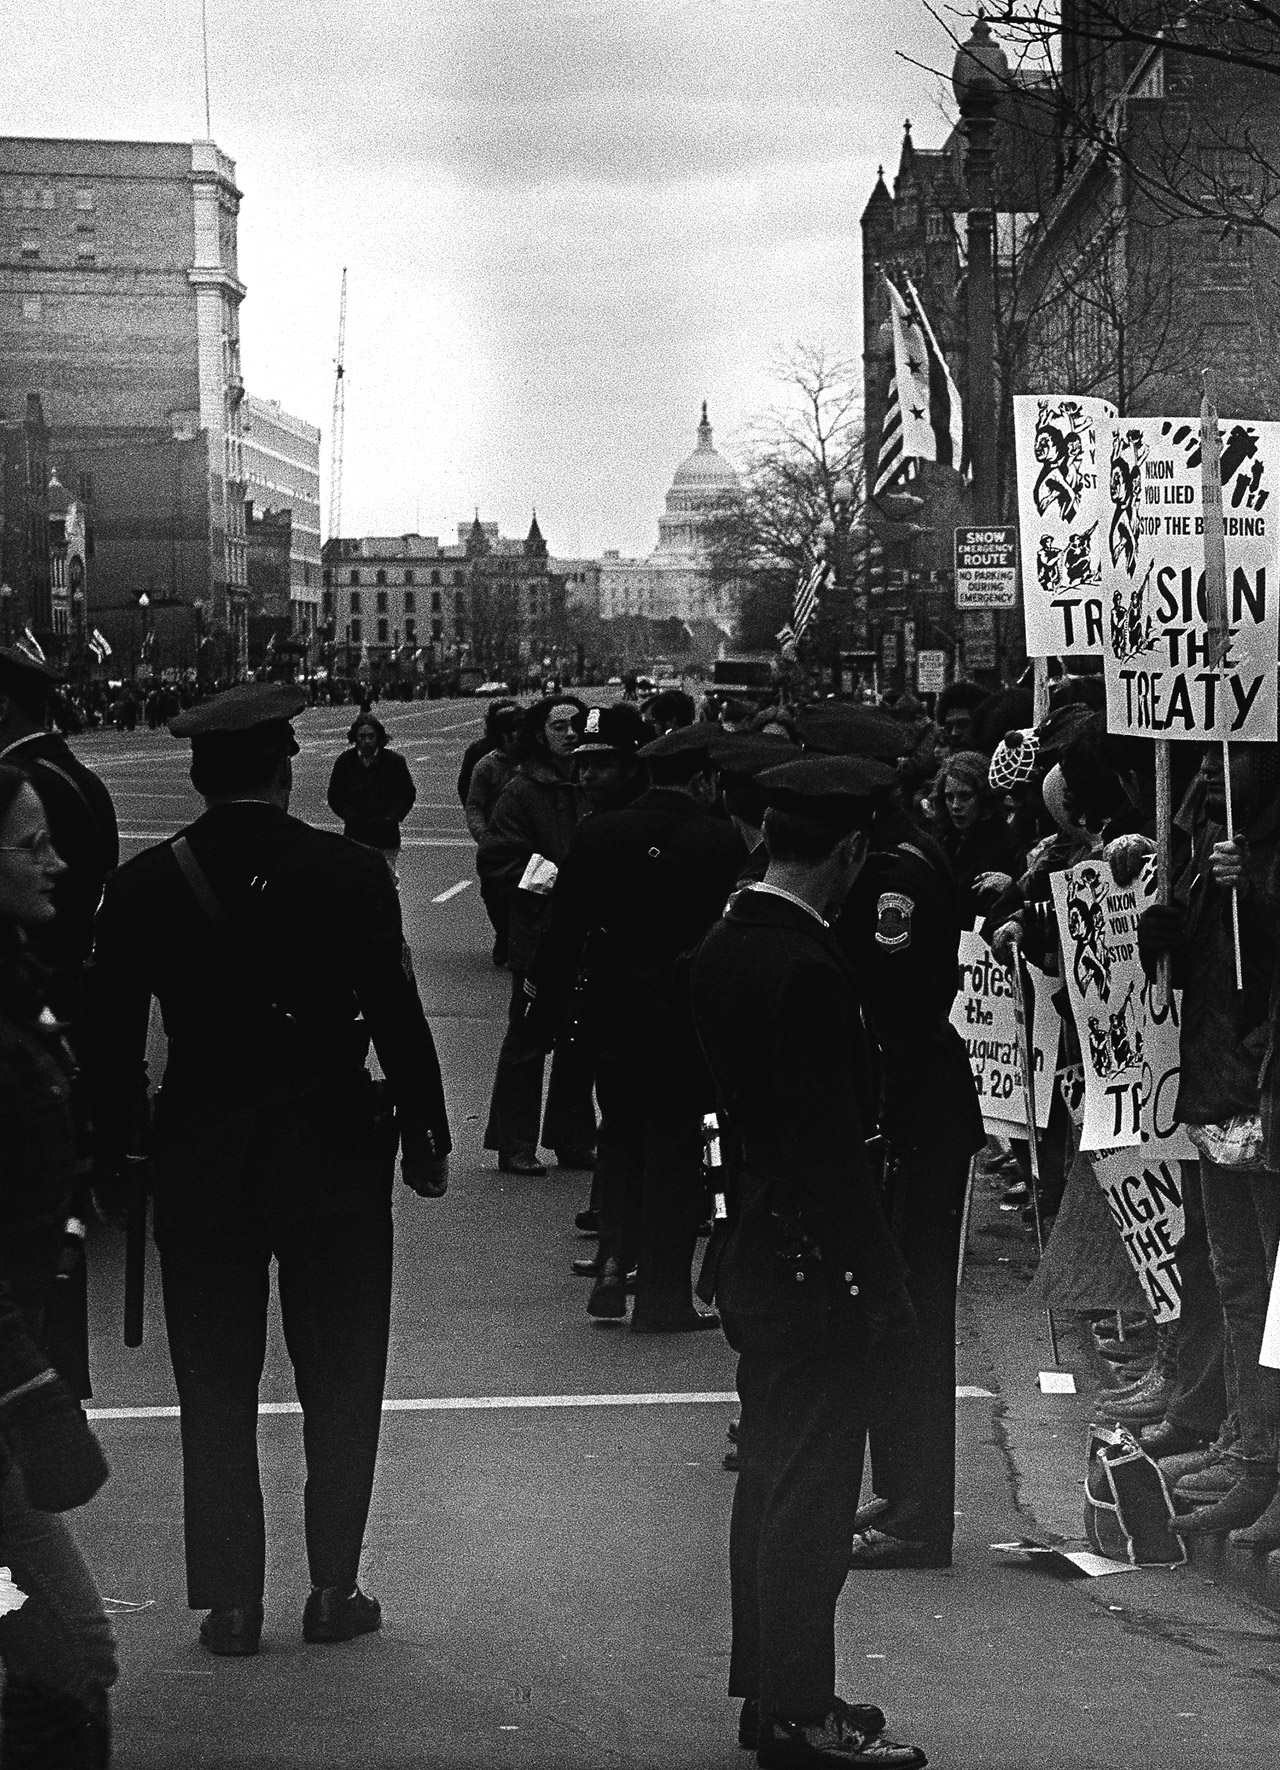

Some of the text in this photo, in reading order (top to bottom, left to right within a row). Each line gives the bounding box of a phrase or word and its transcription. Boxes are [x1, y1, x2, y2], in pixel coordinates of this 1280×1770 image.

[1145, 460, 1174, 480] NIXON
[1144, 485, 1195, 505] YOU LIED
[1140, 516, 1161, 536] STOP
[1164, 516, 1193, 536] THE
[966, 531, 1006, 544] SNOW
[958, 544, 1014, 554] EMERGENCY
[963, 553, 1008, 566] ROUTE
[959, 570, 1014, 581] NO PARKING
[967, 581, 1004, 592] DURING
[959, 592, 1013, 604] EMERGENCY
[1118, 670, 1266, 732] TREATY
[1107, 892, 1136, 913] NIXON
[1109, 915, 1129, 935] YOU
[1109, 943, 1133, 963] STOP
[964, 997, 994, 1026] the
[1124, 1218, 1176, 1266] THE
